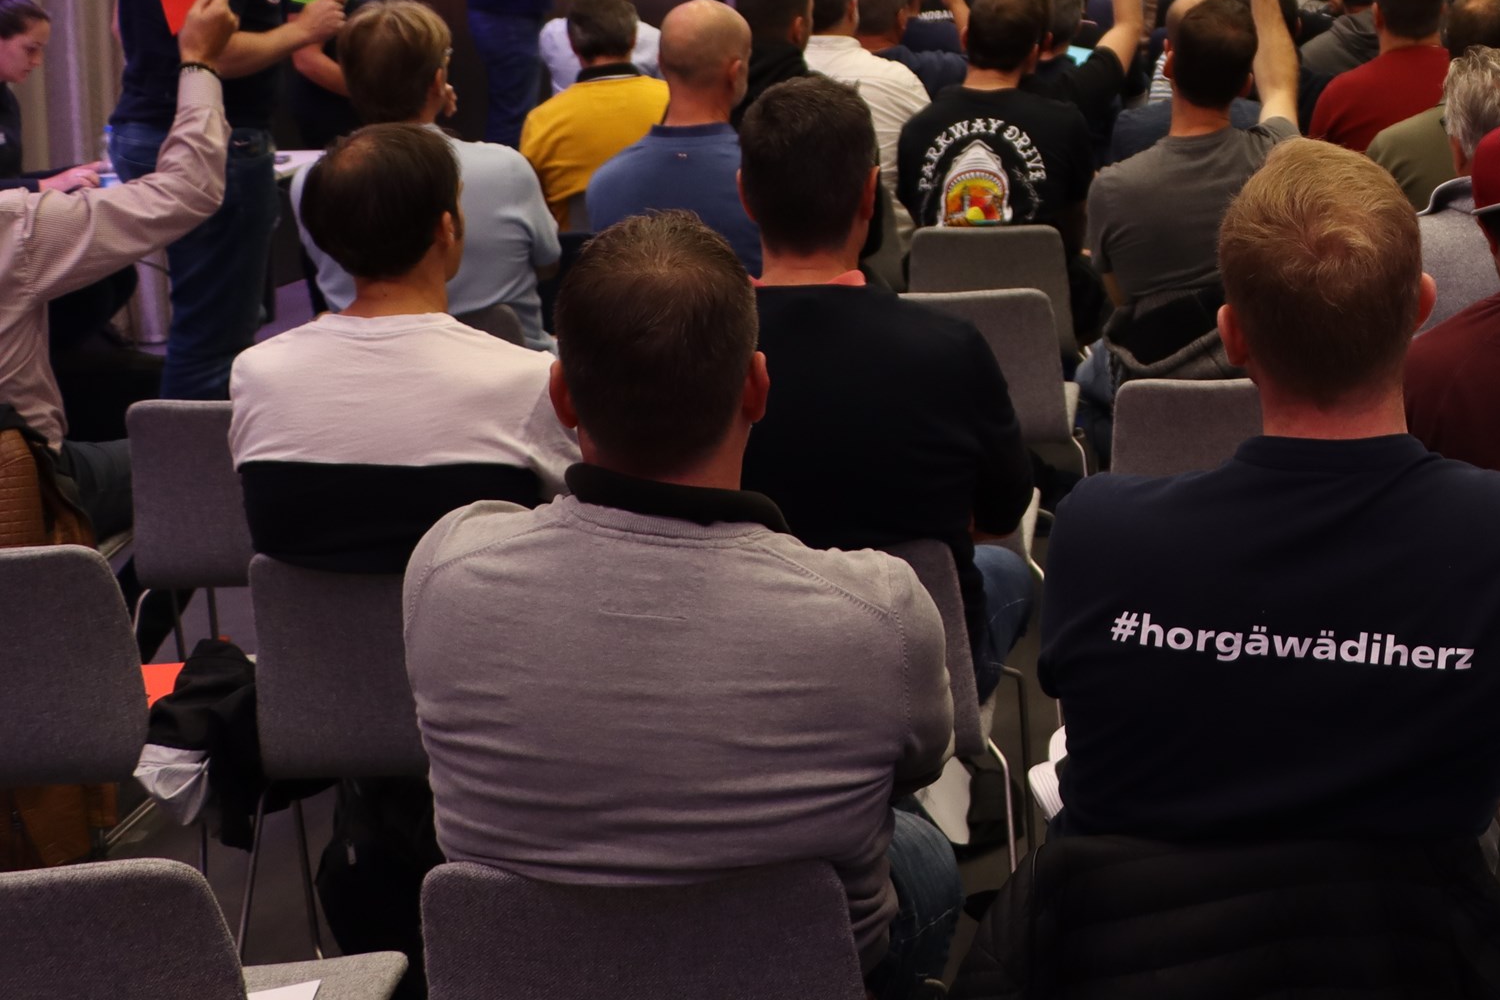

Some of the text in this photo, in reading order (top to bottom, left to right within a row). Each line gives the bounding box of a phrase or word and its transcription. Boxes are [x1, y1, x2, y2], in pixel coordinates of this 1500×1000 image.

[918, 117, 1047, 192] PARKWAY DRIVE
[1110, 620, 1475, 681] #horgäwädiherz
